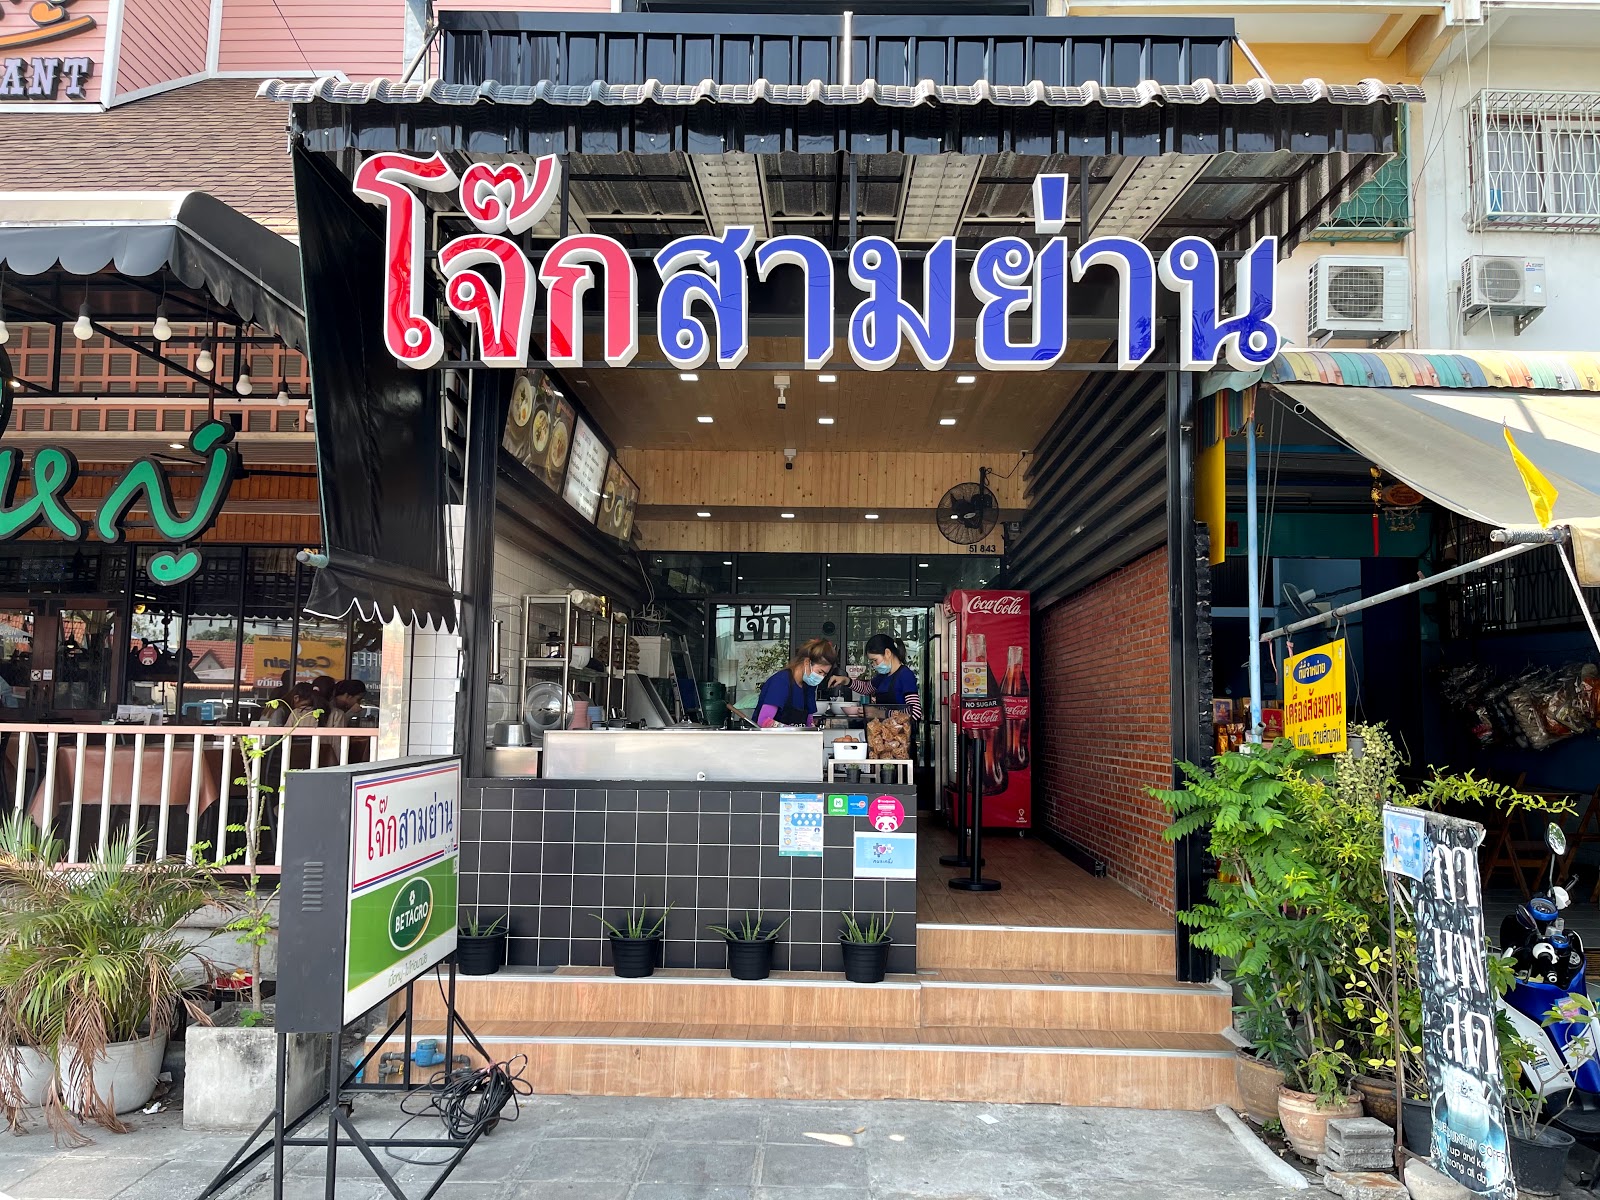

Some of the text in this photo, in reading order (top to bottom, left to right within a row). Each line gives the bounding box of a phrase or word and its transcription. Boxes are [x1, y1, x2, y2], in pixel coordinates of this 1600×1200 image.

[967, 595, 1024, 614] Coca-Cola
[962, 710, 1000, 723] Coca-Cola
[395, 900, 429, 934] BETAGRO
[1462, 1152, 1476, 1165] and
